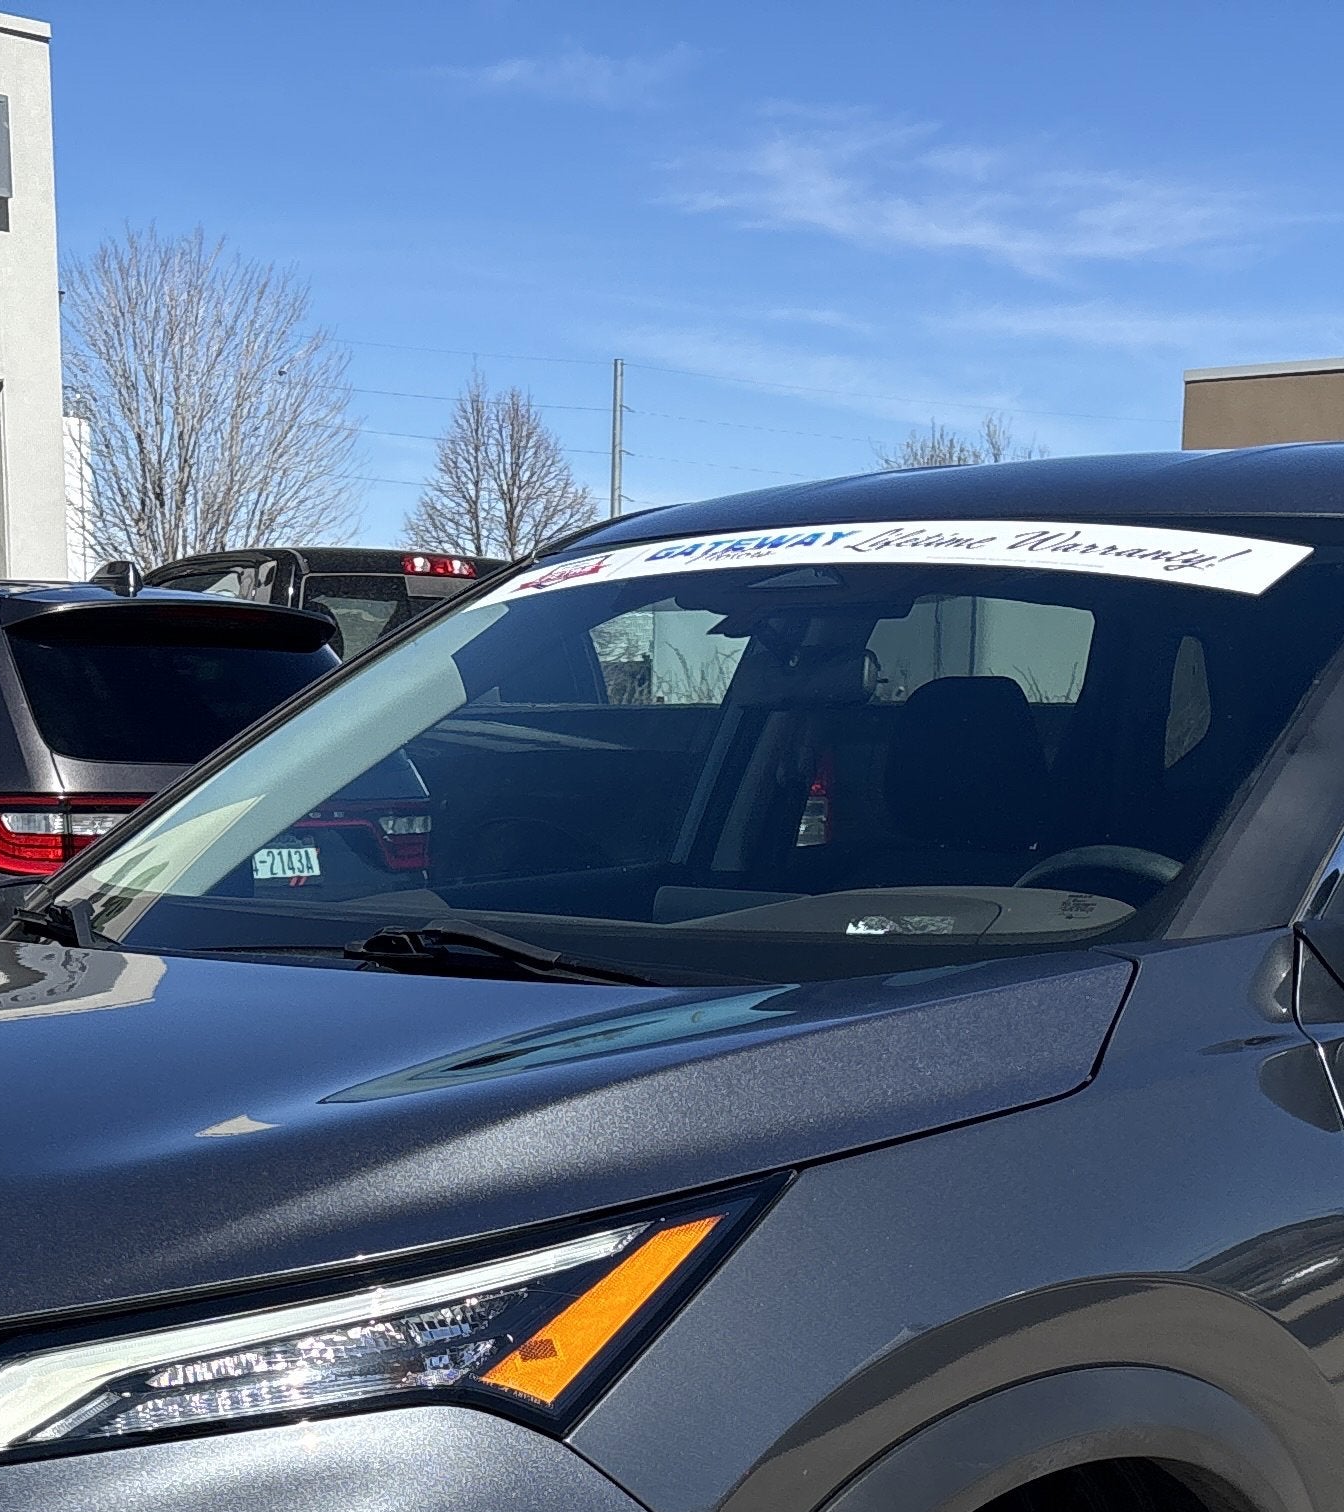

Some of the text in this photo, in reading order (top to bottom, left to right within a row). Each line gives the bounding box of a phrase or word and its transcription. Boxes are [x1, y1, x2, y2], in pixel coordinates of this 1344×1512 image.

[644, 531, 859, 561] GATEWAY
[843, 528, 996, 553] Lifetime
[1006, 531, 1252, 572] Warranty!
